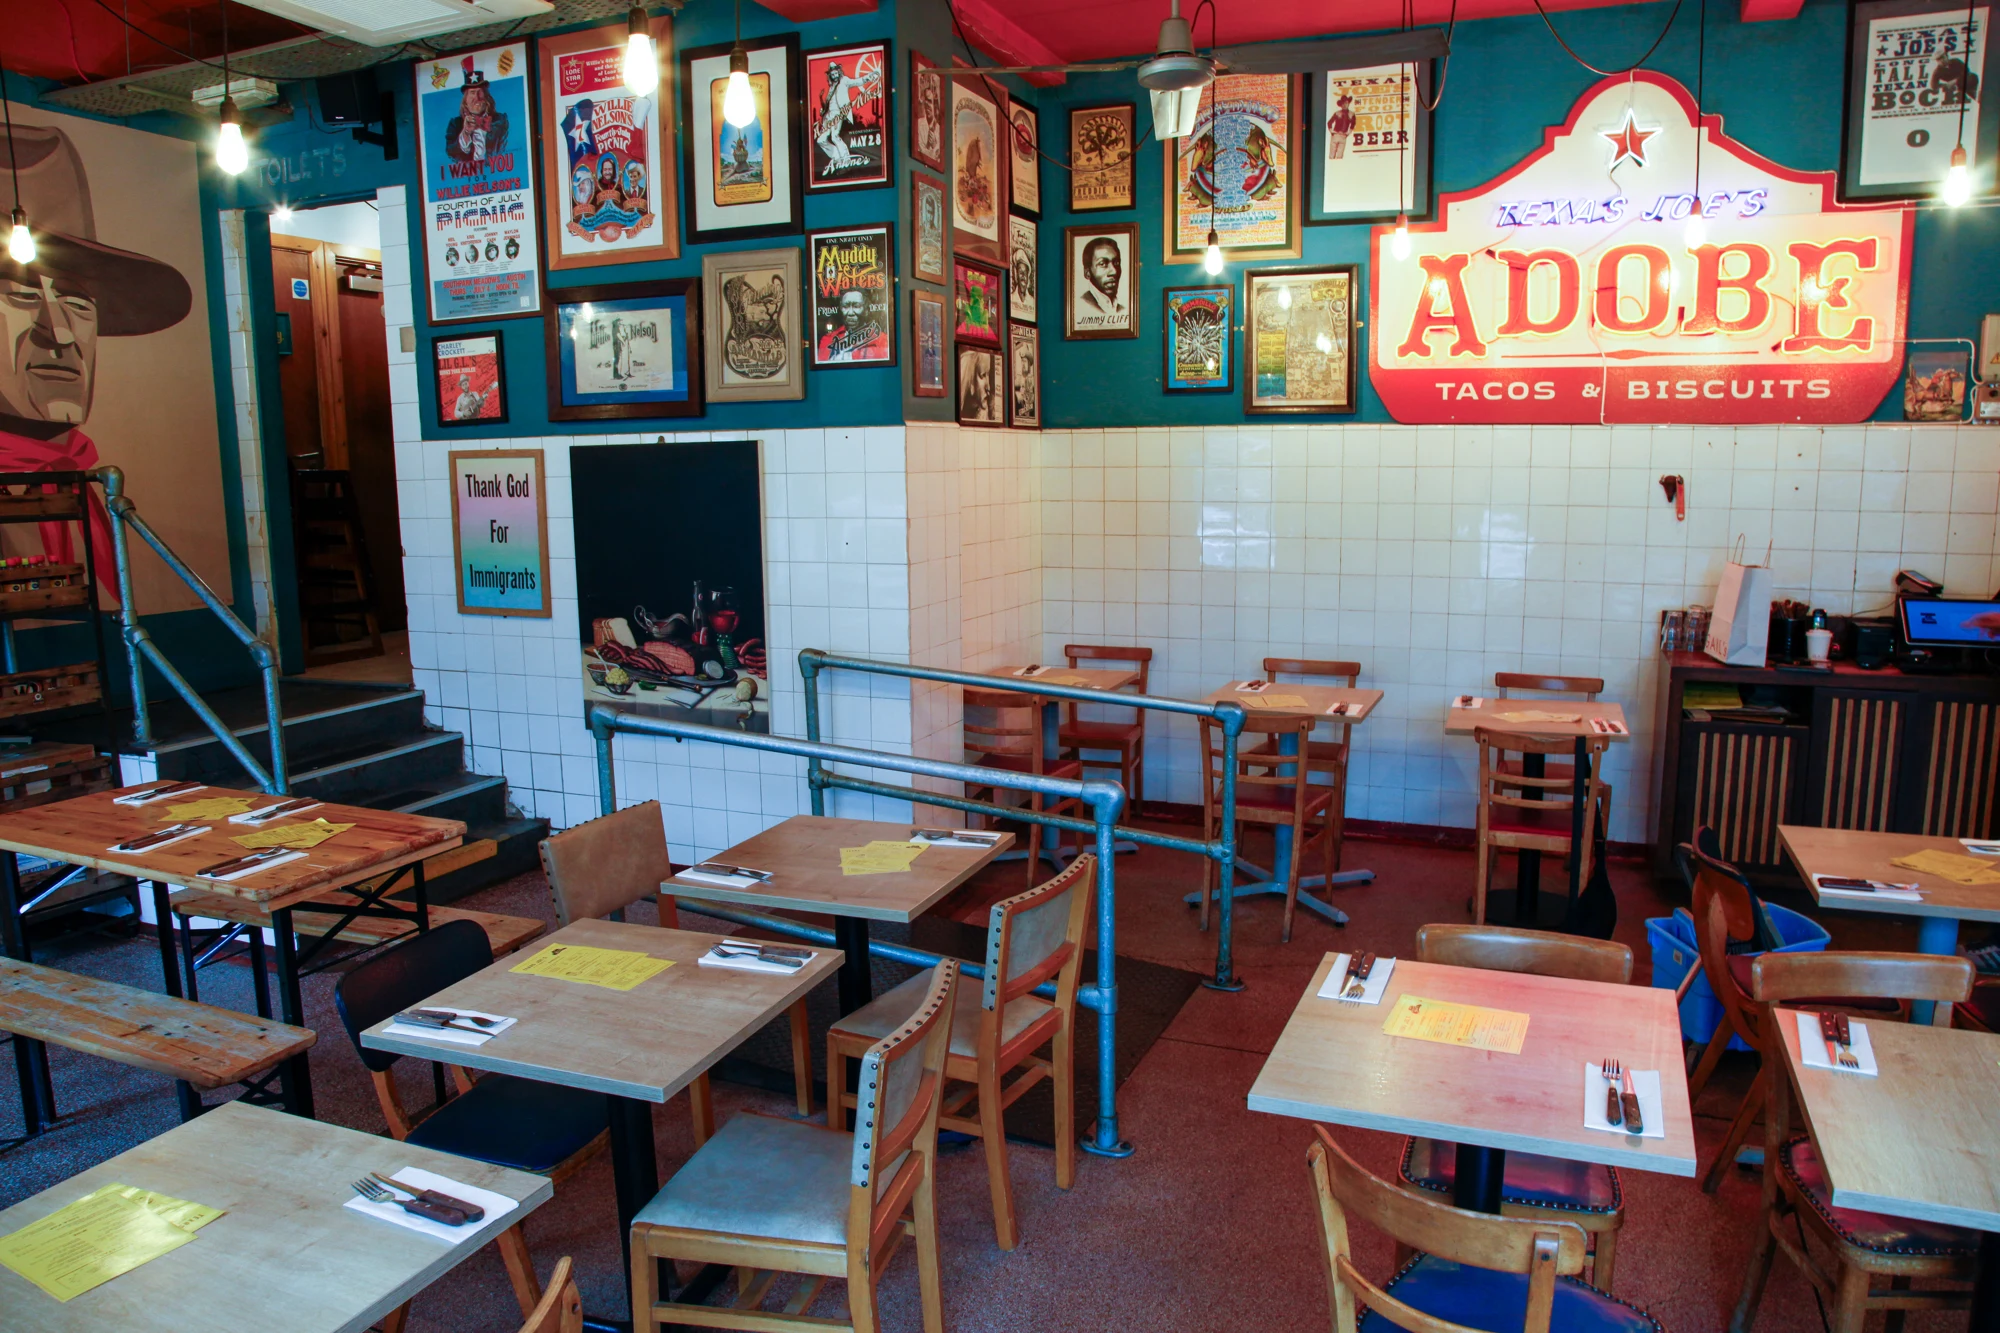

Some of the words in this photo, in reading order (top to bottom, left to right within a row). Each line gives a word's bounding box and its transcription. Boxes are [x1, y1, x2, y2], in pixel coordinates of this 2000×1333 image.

[1877, 25, 1979, 42] TEXAS
[1894, 36, 1958, 57] JOE'S
[1874, 58, 1930, 68] LONG
[1874, 64, 1928, 83] TALL
[1333, 76, 1411, 87] TEXAS
[1873, 80, 1928, 92] TEXAN
[594, 98, 634, 116] WILLIE
[592, 110, 634, 131] NELSON'S
[1356, 113, 1410, 132] ROOT
[575, 123, 584, 142] 7
[850, 135, 867, 148] MAY
[868, 133, 882, 146] 28
[1353, 130, 1408, 146] BEER
[598, 136, 630, 154] PICNIC
[253, 144, 347, 188] TOILETS
[441, 165, 445, 181] I
[448, 160, 485, 179] WANT
[488, 153, 514, 174] YOU
[822, 155, 871, 176] Antone's
[436, 184, 470, 199] WILLIE
[472, 177, 520, 194] NELSON'S
[437, 200, 478, 212] FOURTH
[480, 197, 494, 206] OF
[498, 193, 521, 203] JULY
[1498, 196, 1627, 227] TEXAS
[1640, 188, 1768, 221] JOE'S
[436, 202, 524, 231] PICNIC
[818, 245, 877, 272] Muddy
[818, 267, 885, 297] Waters
[1397, 235, 1880, 358] ADOBE
[818, 306, 839, 316] FRIDAY
[1077, 315, 1105, 325] JIMMY
[1107, 315, 1129, 324] CLIFF
[630, 321, 658, 343] Nelson
[828, 322, 881, 360] Antone's
[438, 348, 465, 356] CROCKETT
[1436, 382, 1556, 400] TACOS
[1582, 383, 1601, 398] &
[1628, 380, 1831, 400] BISCUITS
[465, 474, 502, 498] Thank
[507, 473, 529, 498] God
[490, 519, 509, 544] For
[470, 564, 536, 595] Immigrants
[1706, 634, 1727, 658] GAIL'S
